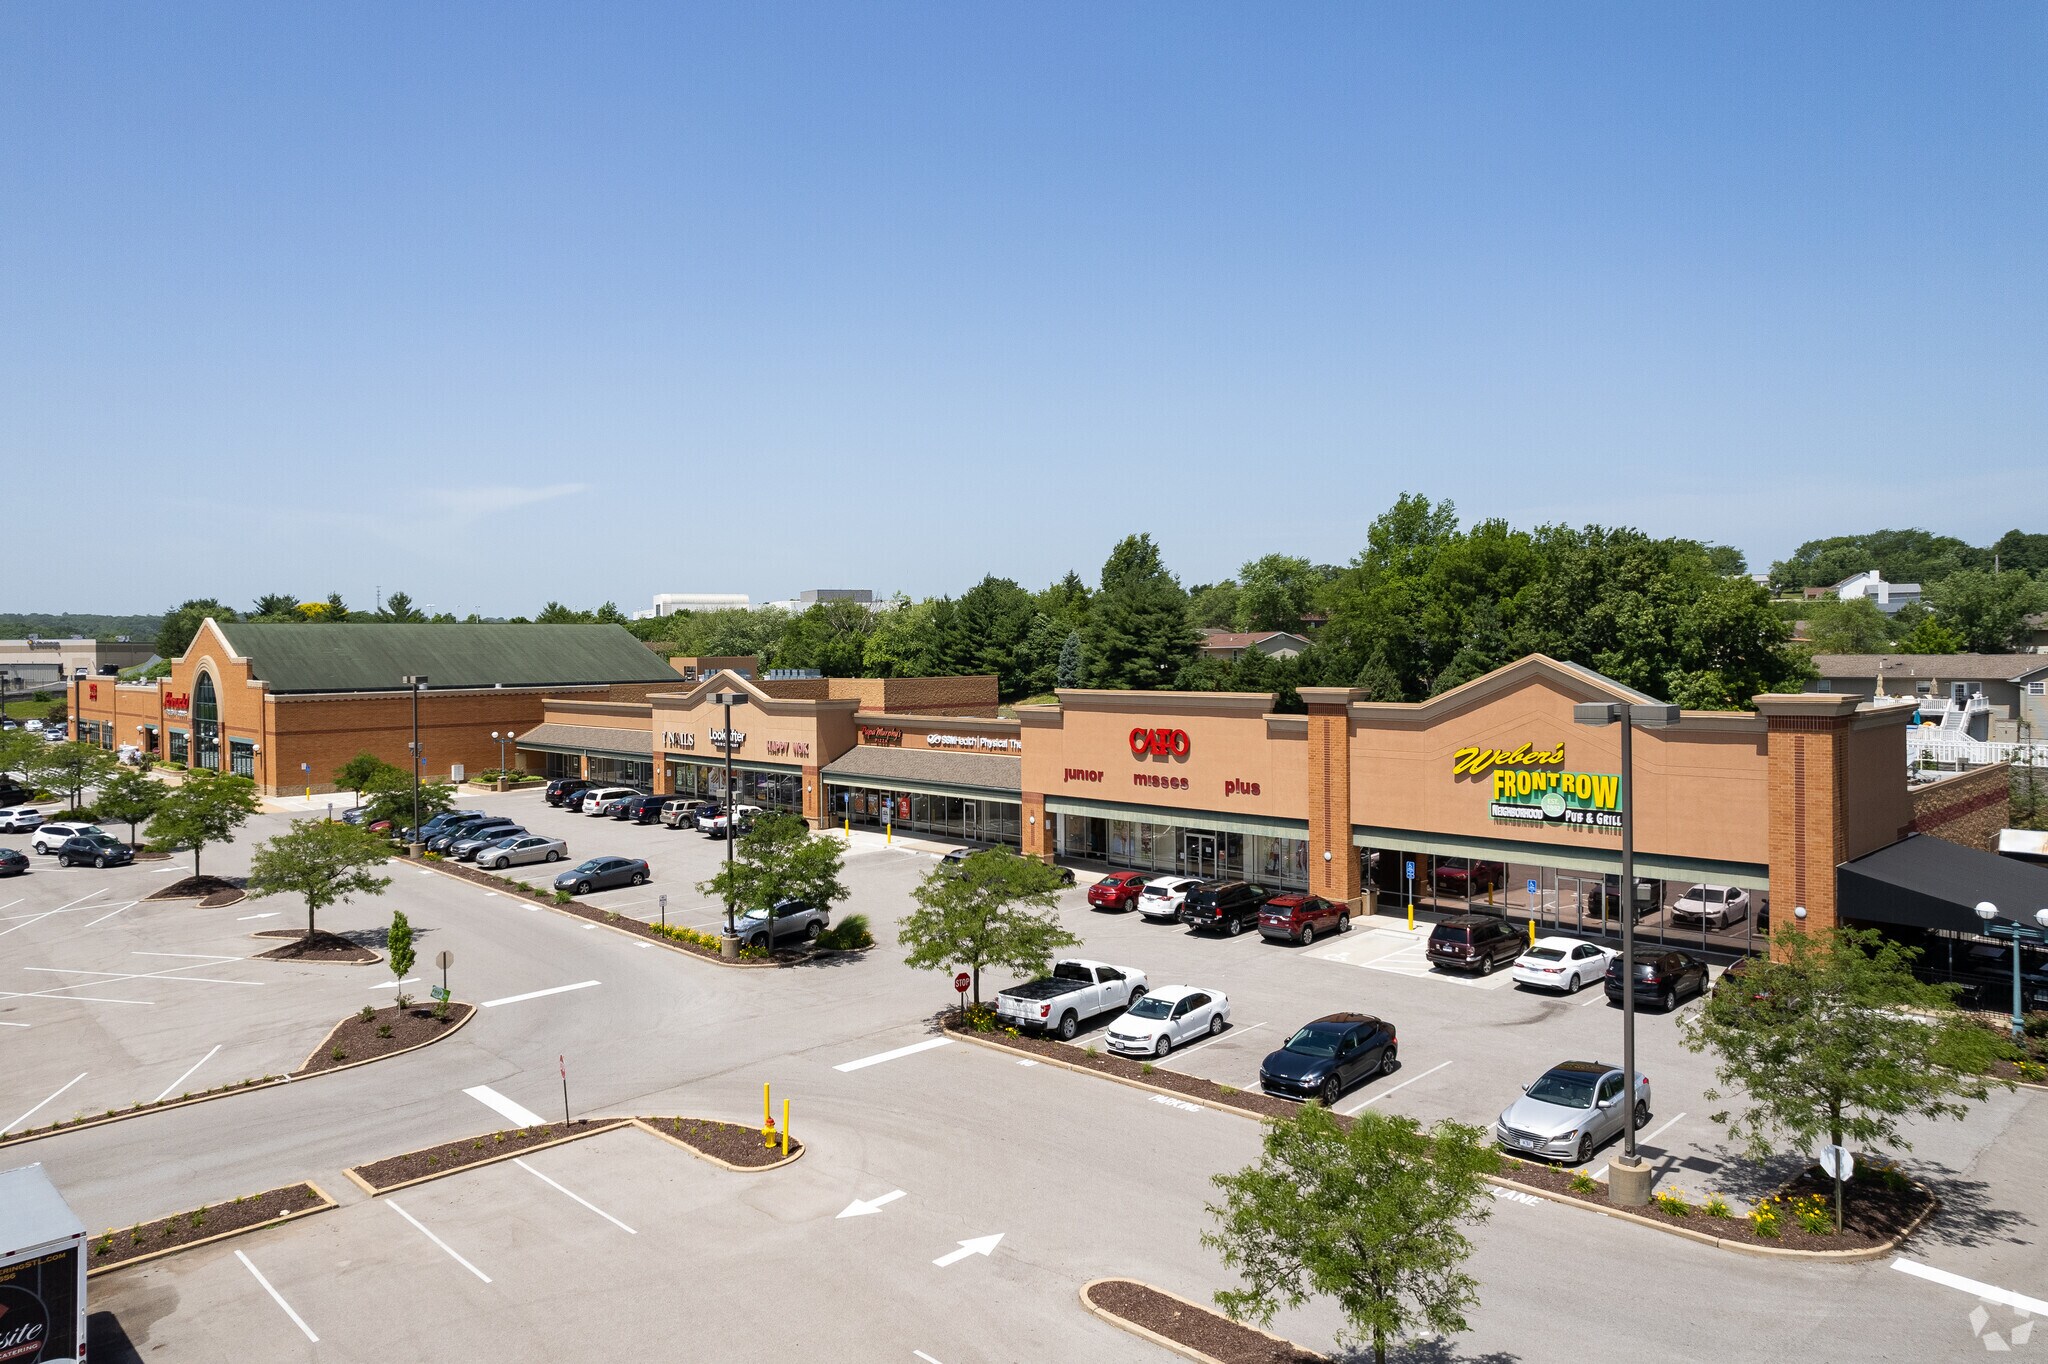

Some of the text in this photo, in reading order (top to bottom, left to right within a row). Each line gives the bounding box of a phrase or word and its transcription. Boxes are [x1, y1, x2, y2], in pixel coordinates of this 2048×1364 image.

[668, 732, 694, 746] NAILS
[708, 728, 745, 743] Lookfter
[980, 737, 1008, 750] Physical
[1129, 727, 1190, 756] CATO
[767, 740, 809, 754] HAPPY WOK
[1452, 741, 1565, 775] Weber's
[1063, 768, 1261, 797] junior misses plus
[1493, 769, 1619, 809] FRONT ROW
[1491, 804, 1622, 826] NEIGHBORHOOD PUB & GRILL
[955, 977, 970, 988] STOP
[1147, 1094, 1205, 1113] PARKING
[1491, 1186, 1544, 1207] LANE
